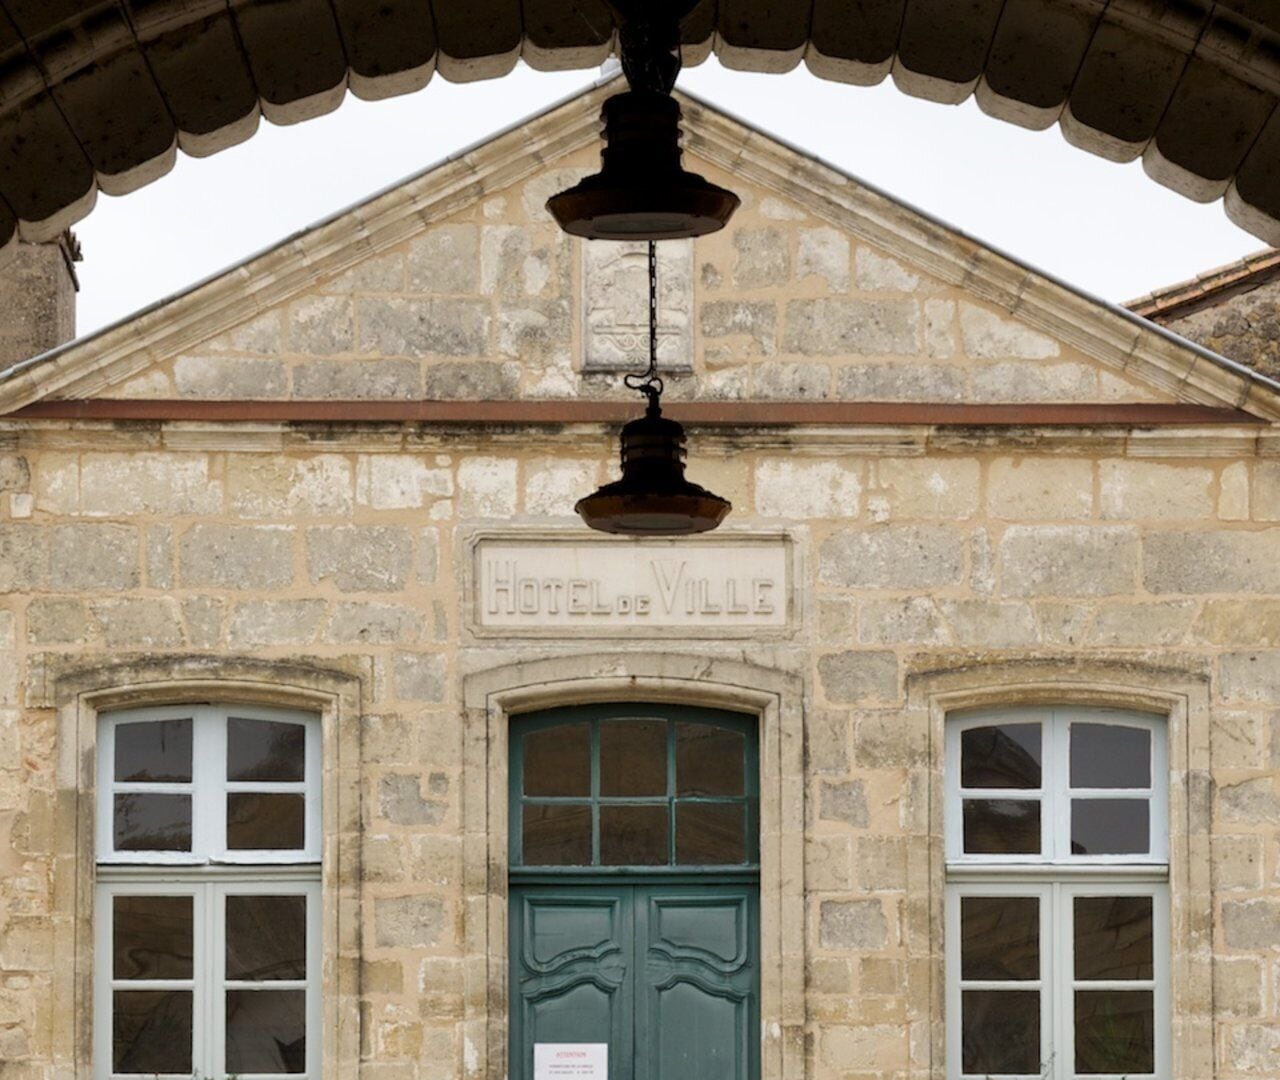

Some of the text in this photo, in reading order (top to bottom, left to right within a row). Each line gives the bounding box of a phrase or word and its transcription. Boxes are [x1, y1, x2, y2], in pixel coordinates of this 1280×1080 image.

[486, 559, 774, 616] HOTEL DE VILLE
